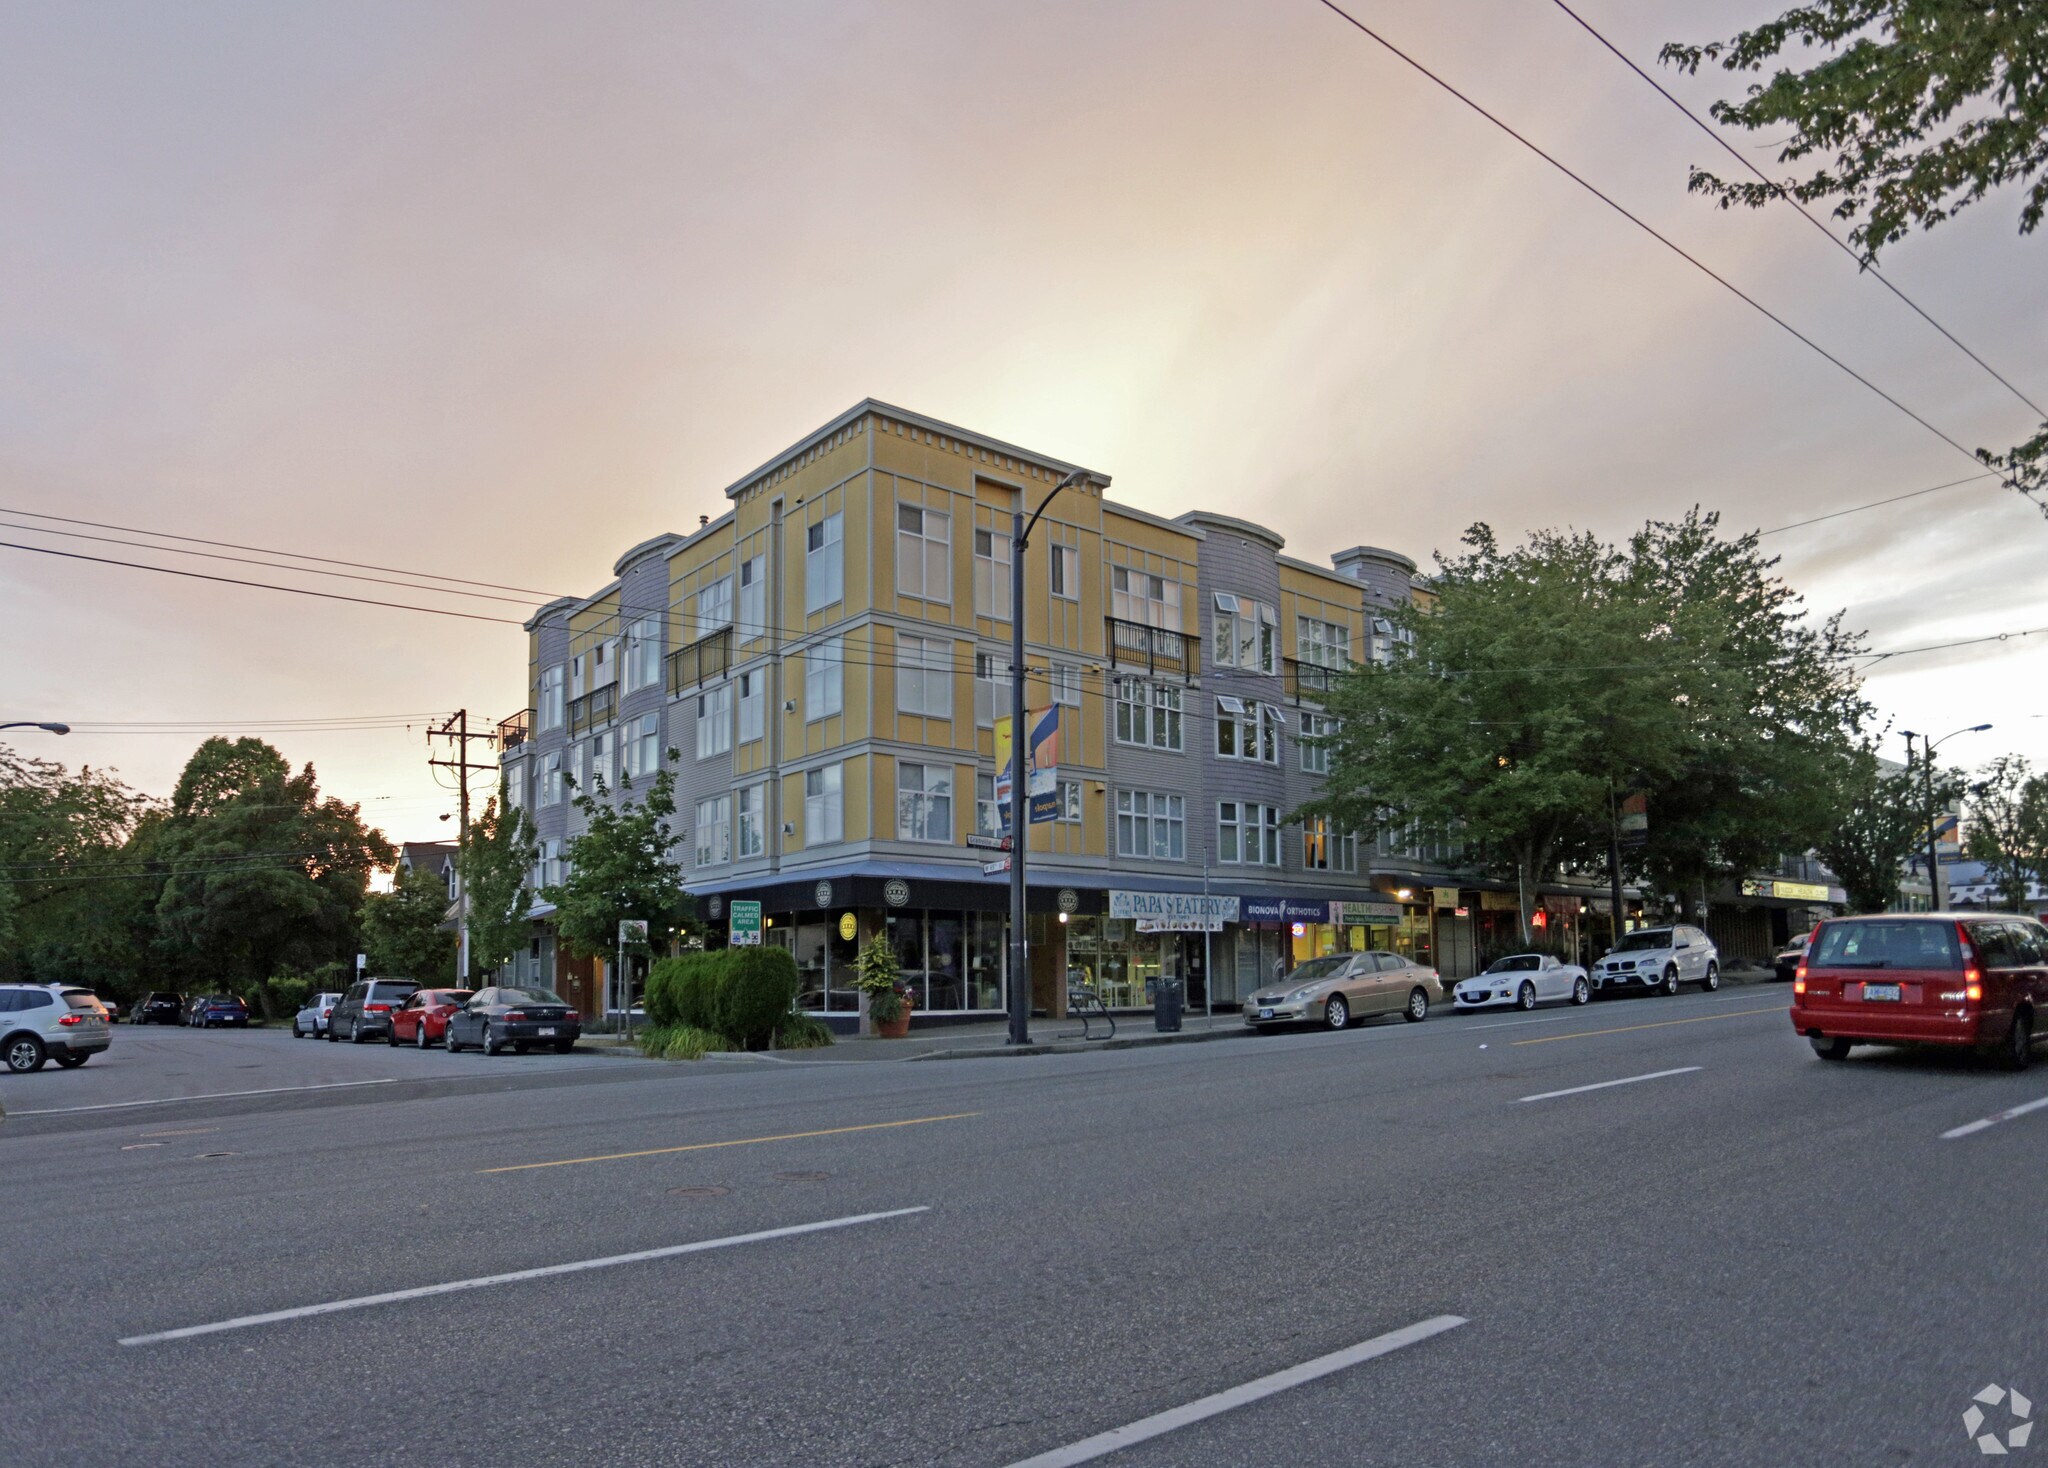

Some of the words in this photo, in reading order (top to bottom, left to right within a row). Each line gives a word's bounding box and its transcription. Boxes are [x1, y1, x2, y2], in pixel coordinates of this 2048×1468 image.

[1133, 895, 1172, 914] PAPA'S
[1176, 896, 1221, 915] EATERY
[1248, 905, 1279, 915] BIONOVA
[1286, 907, 1320, 916] ORTHOTICS
